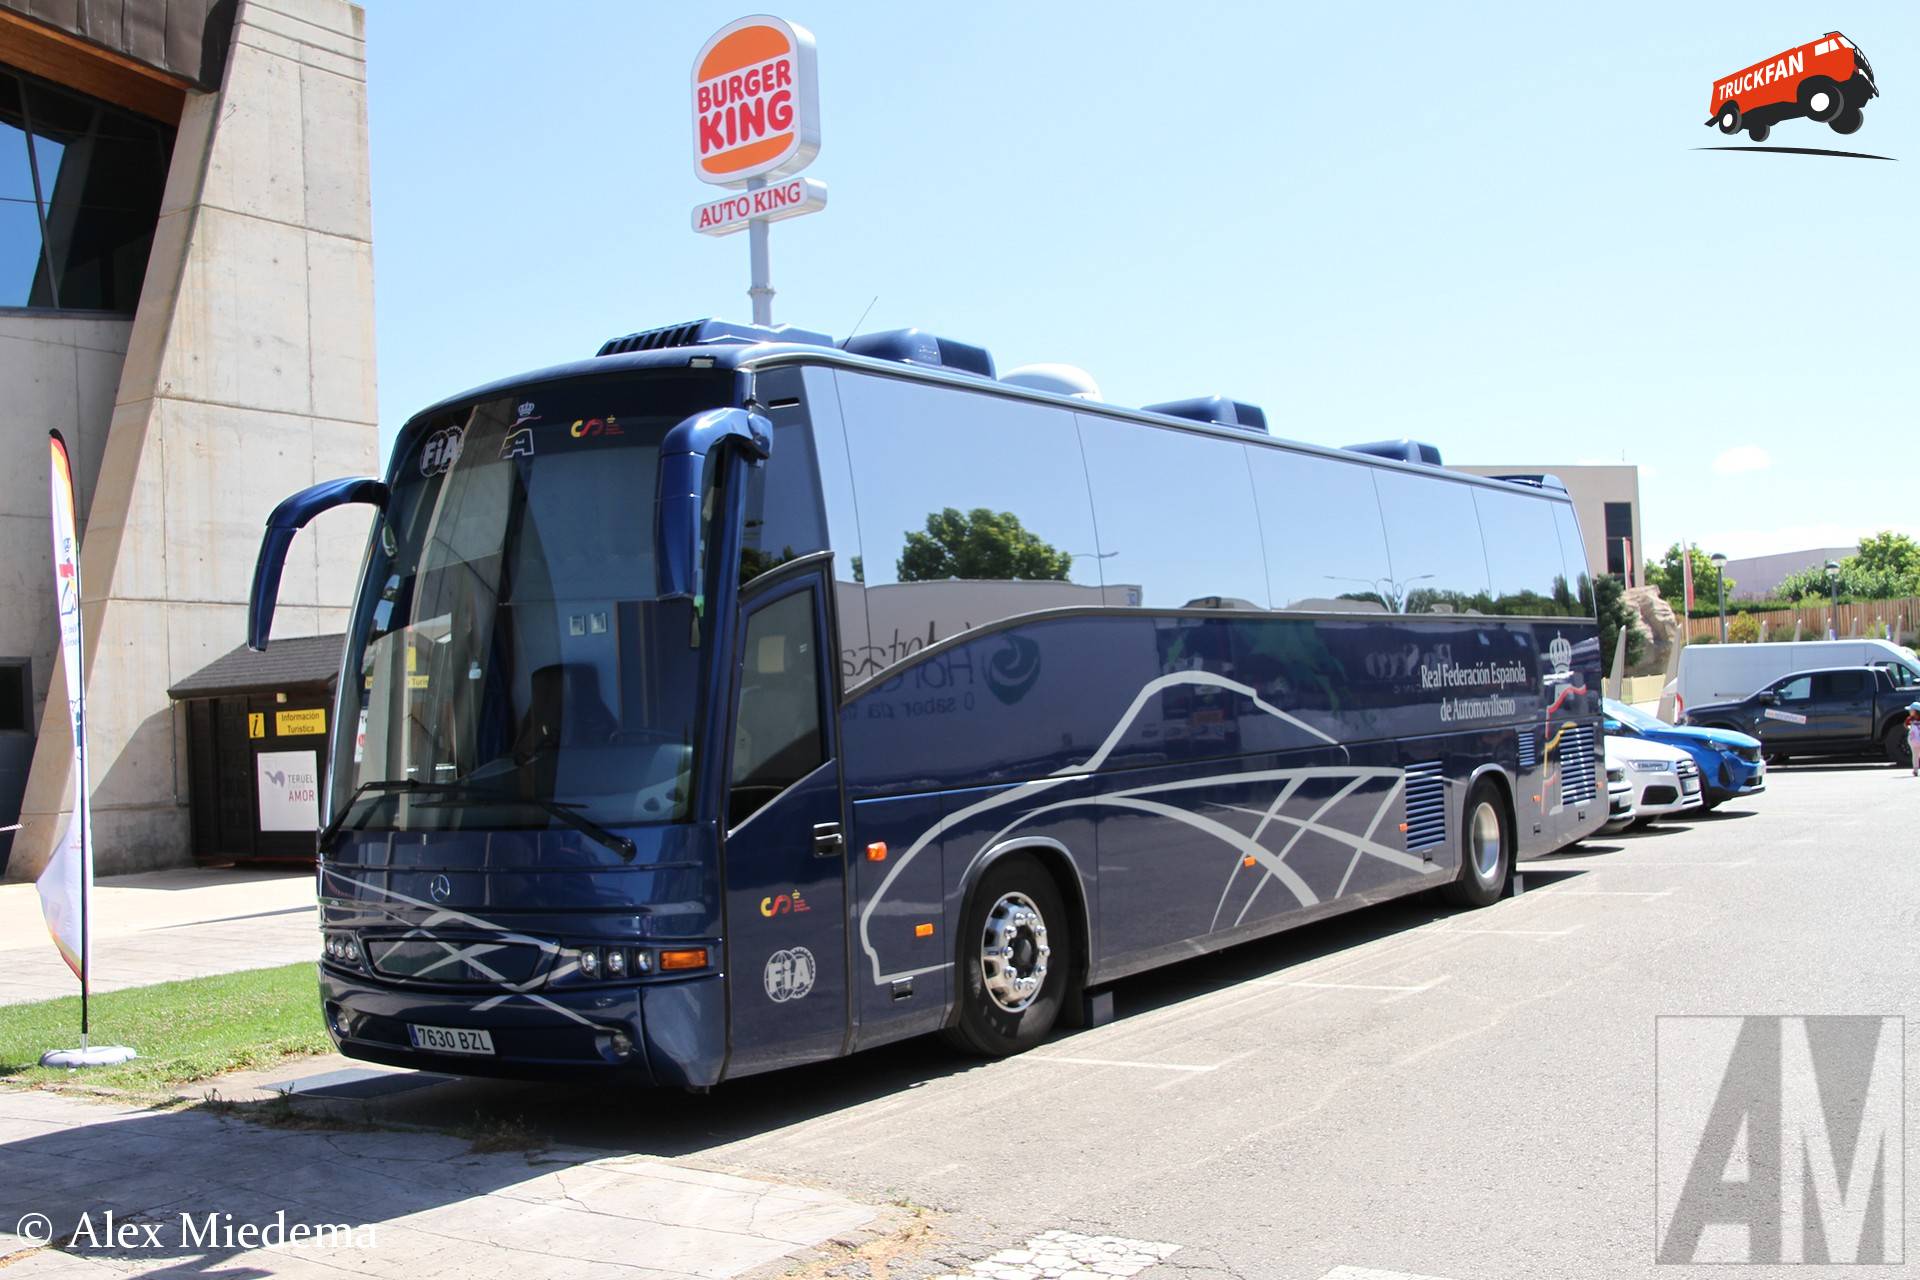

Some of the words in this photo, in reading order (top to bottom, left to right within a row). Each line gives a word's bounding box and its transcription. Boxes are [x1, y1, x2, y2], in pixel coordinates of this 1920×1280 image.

[698, 59, 791, 114] BURGER
[699, 90, 794, 154] KING
[699, 197, 750, 228] AUTO
[754, 182, 801, 213] KING
[1421, 663, 1442, 688] Real
[1443, 662, 1490, 686] Federación
[1491, 660, 1527, 689] Española
[1440, 697, 1451, 722] de
[1453, 694, 1516, 720] Automovilismo
[288, 774, 314, 784] TERUEL
[288, 789, 315, 802] AMOR
[417, 1028, 456, 1048] 7630
[458, 1032, 491, 1051] BZL
